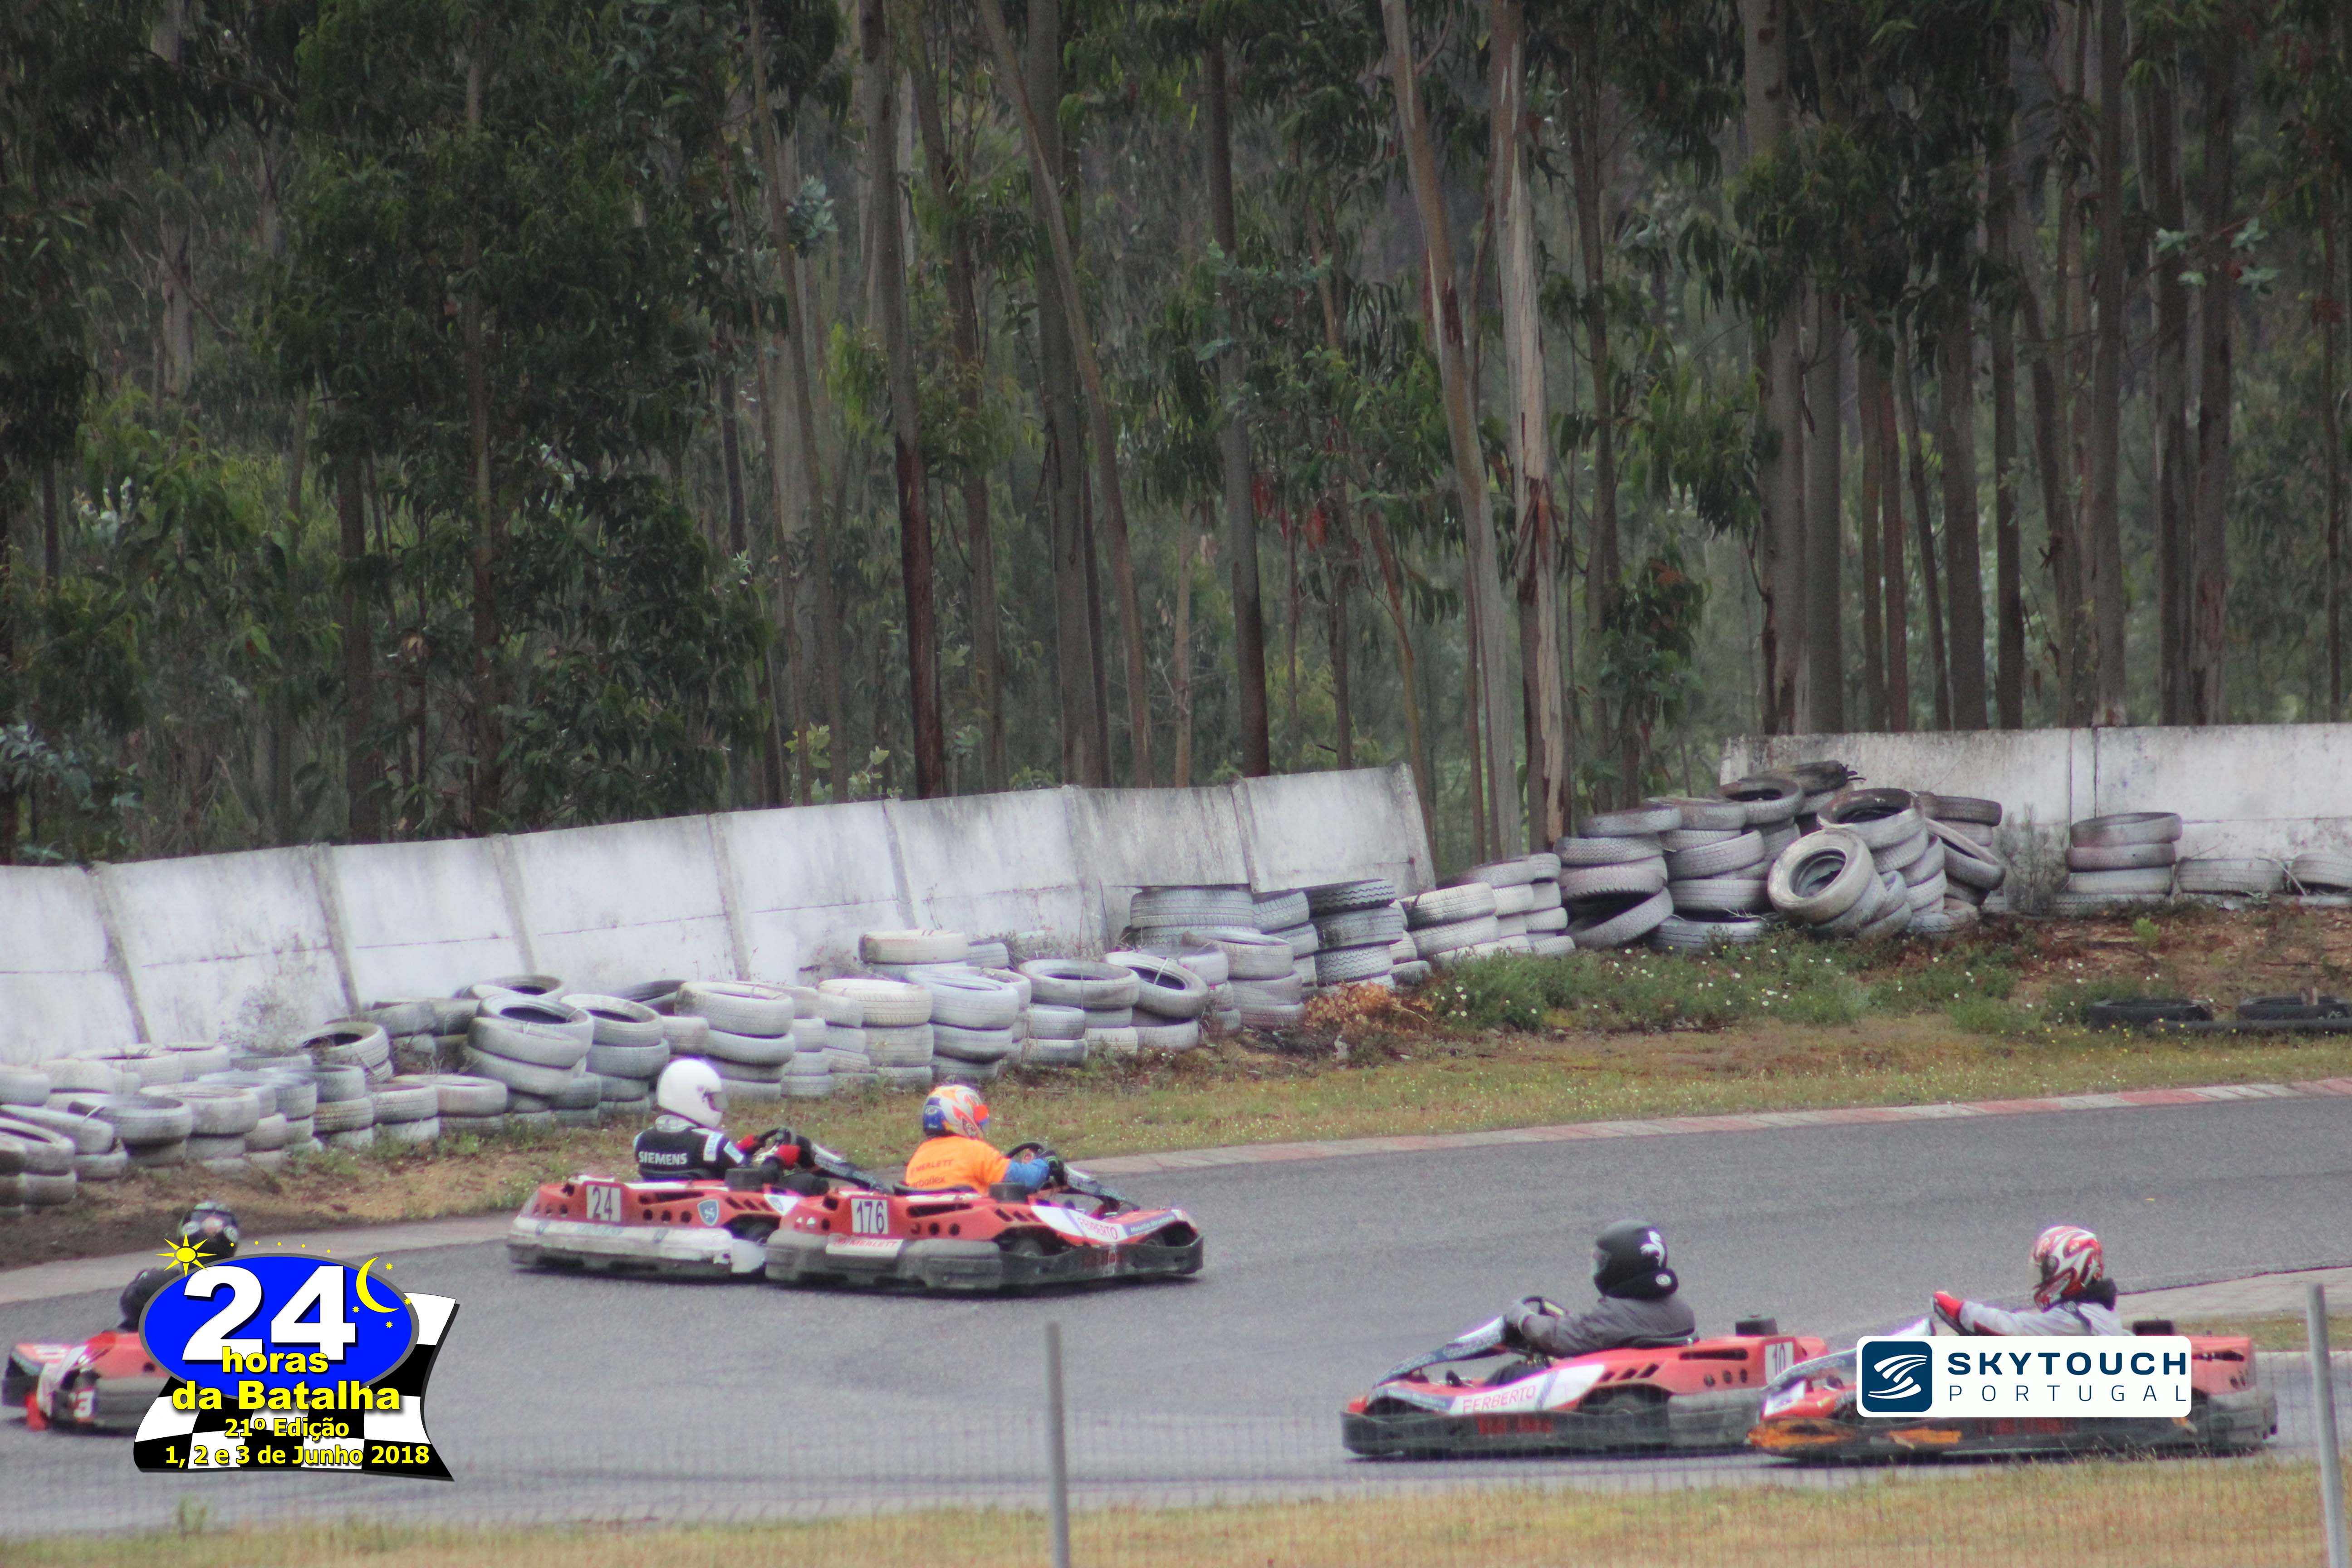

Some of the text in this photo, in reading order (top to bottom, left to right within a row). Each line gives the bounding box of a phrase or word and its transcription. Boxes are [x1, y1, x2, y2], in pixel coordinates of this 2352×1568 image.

[638, 1151, 688, 1166] SIEMENS
[915, 1159, 954, 1171] MERLETT
[592, 1186, 612, 1221] 24
[856, 1200, 885, 1235] 176
[1463, 1385, 1536, 1414] FERBERTO
